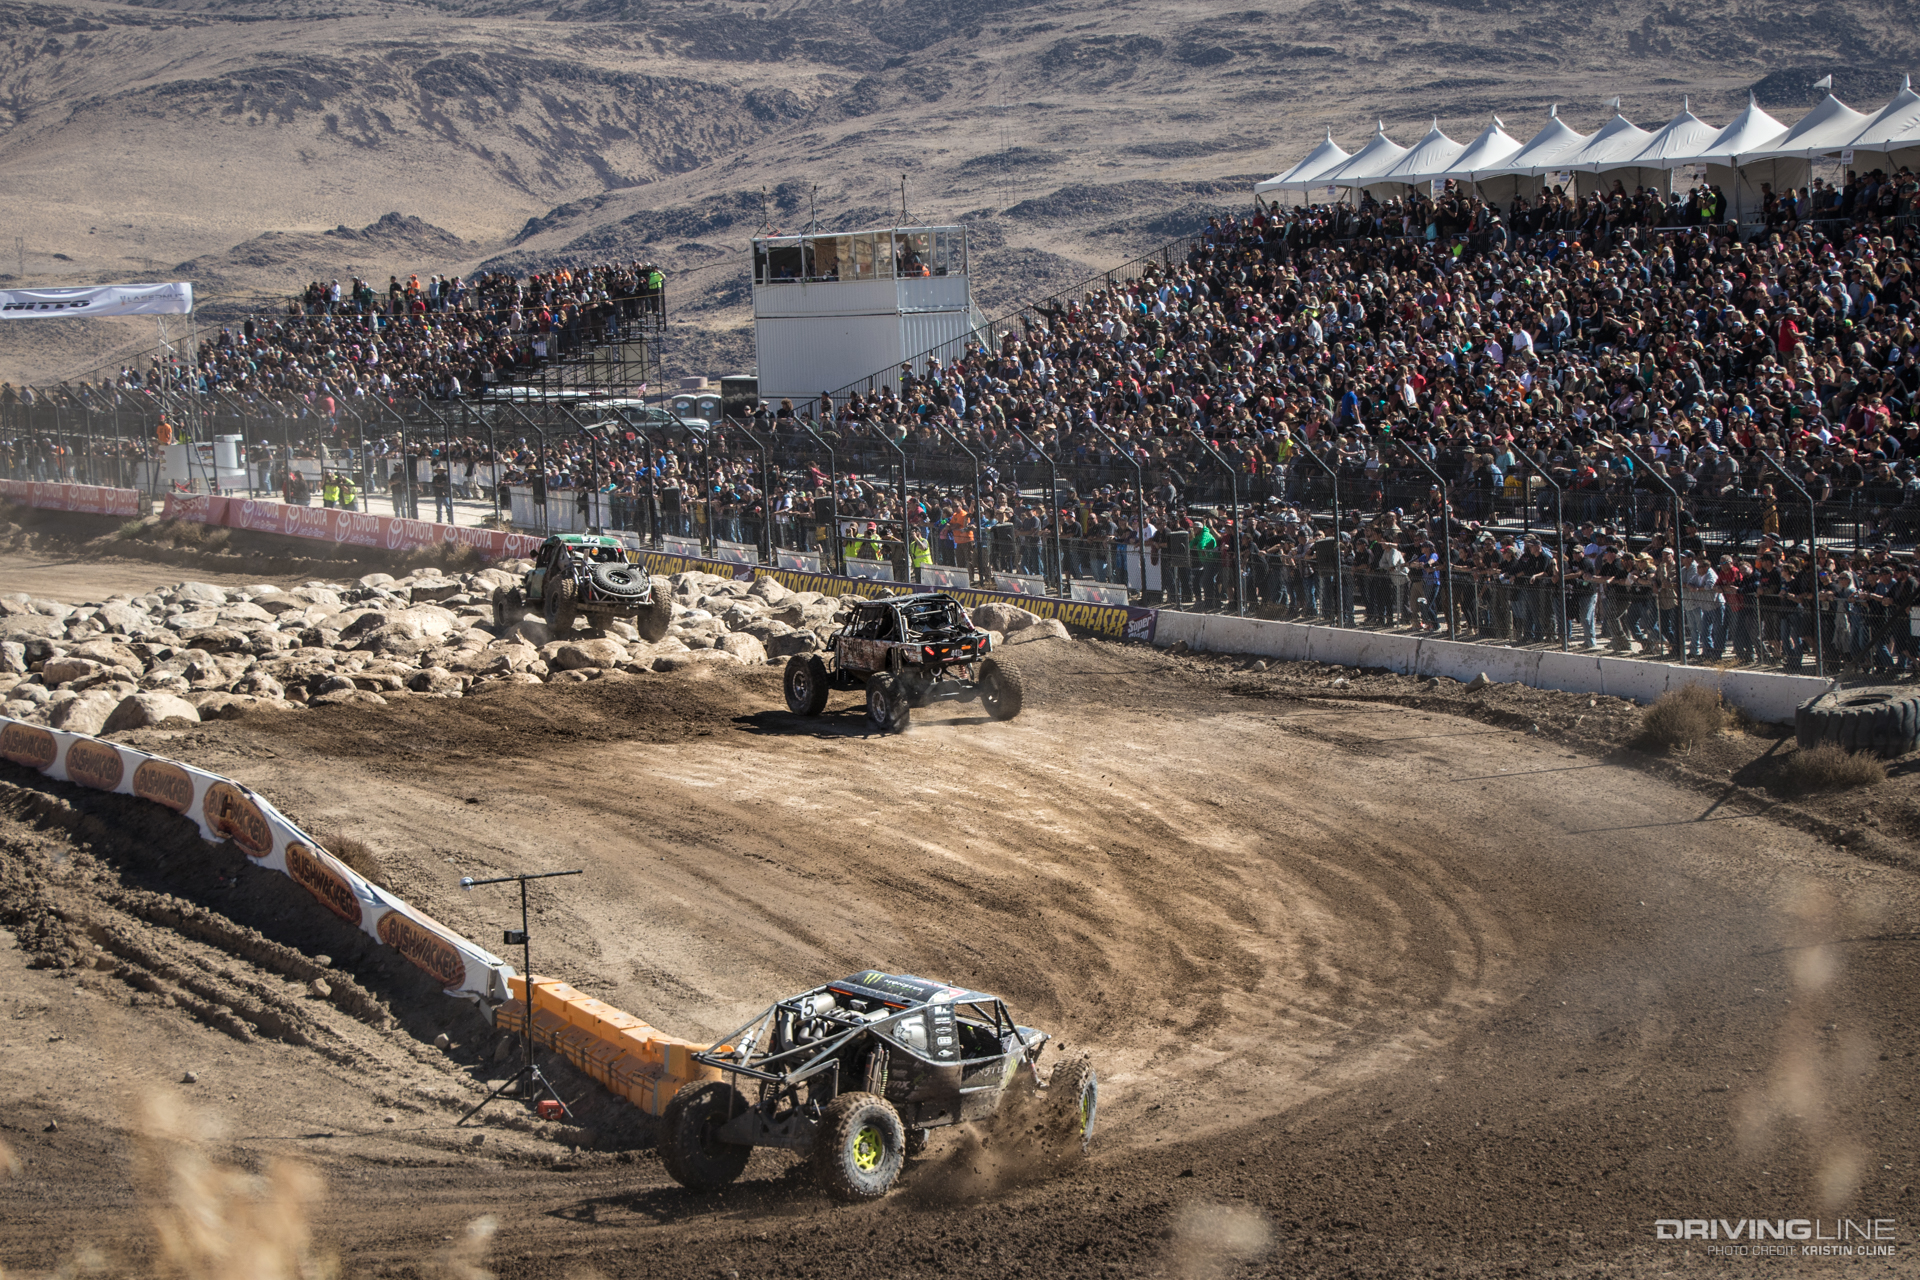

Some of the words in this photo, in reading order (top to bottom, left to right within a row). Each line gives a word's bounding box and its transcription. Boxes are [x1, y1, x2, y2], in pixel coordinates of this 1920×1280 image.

[3, 301, 90, 311] NITTO
[255, 501, 279, 519] TOYOTA
[302, 507, 327, 526] TOYOTA
[352, 514, 380, 533] TOYOTA
[405, 520, 434, 541] TOYOTA
[460, 528, 492, 549] TOYOTA
[810, 576, 854, 596] CLEANER
[1057, 603, 1128, 637] DEGREASER
[3, 730, 53, 760] BUSHWACKER
[70, 747, 120, 781] BUSHWACKER
[138, 767, 190, 807] BUSHWACKER
[291, 850, 356, 916] BUSHWACKER
[389, 918, 459, 979] BUSHWACKER
[803, 997, 815, 1017] 5
